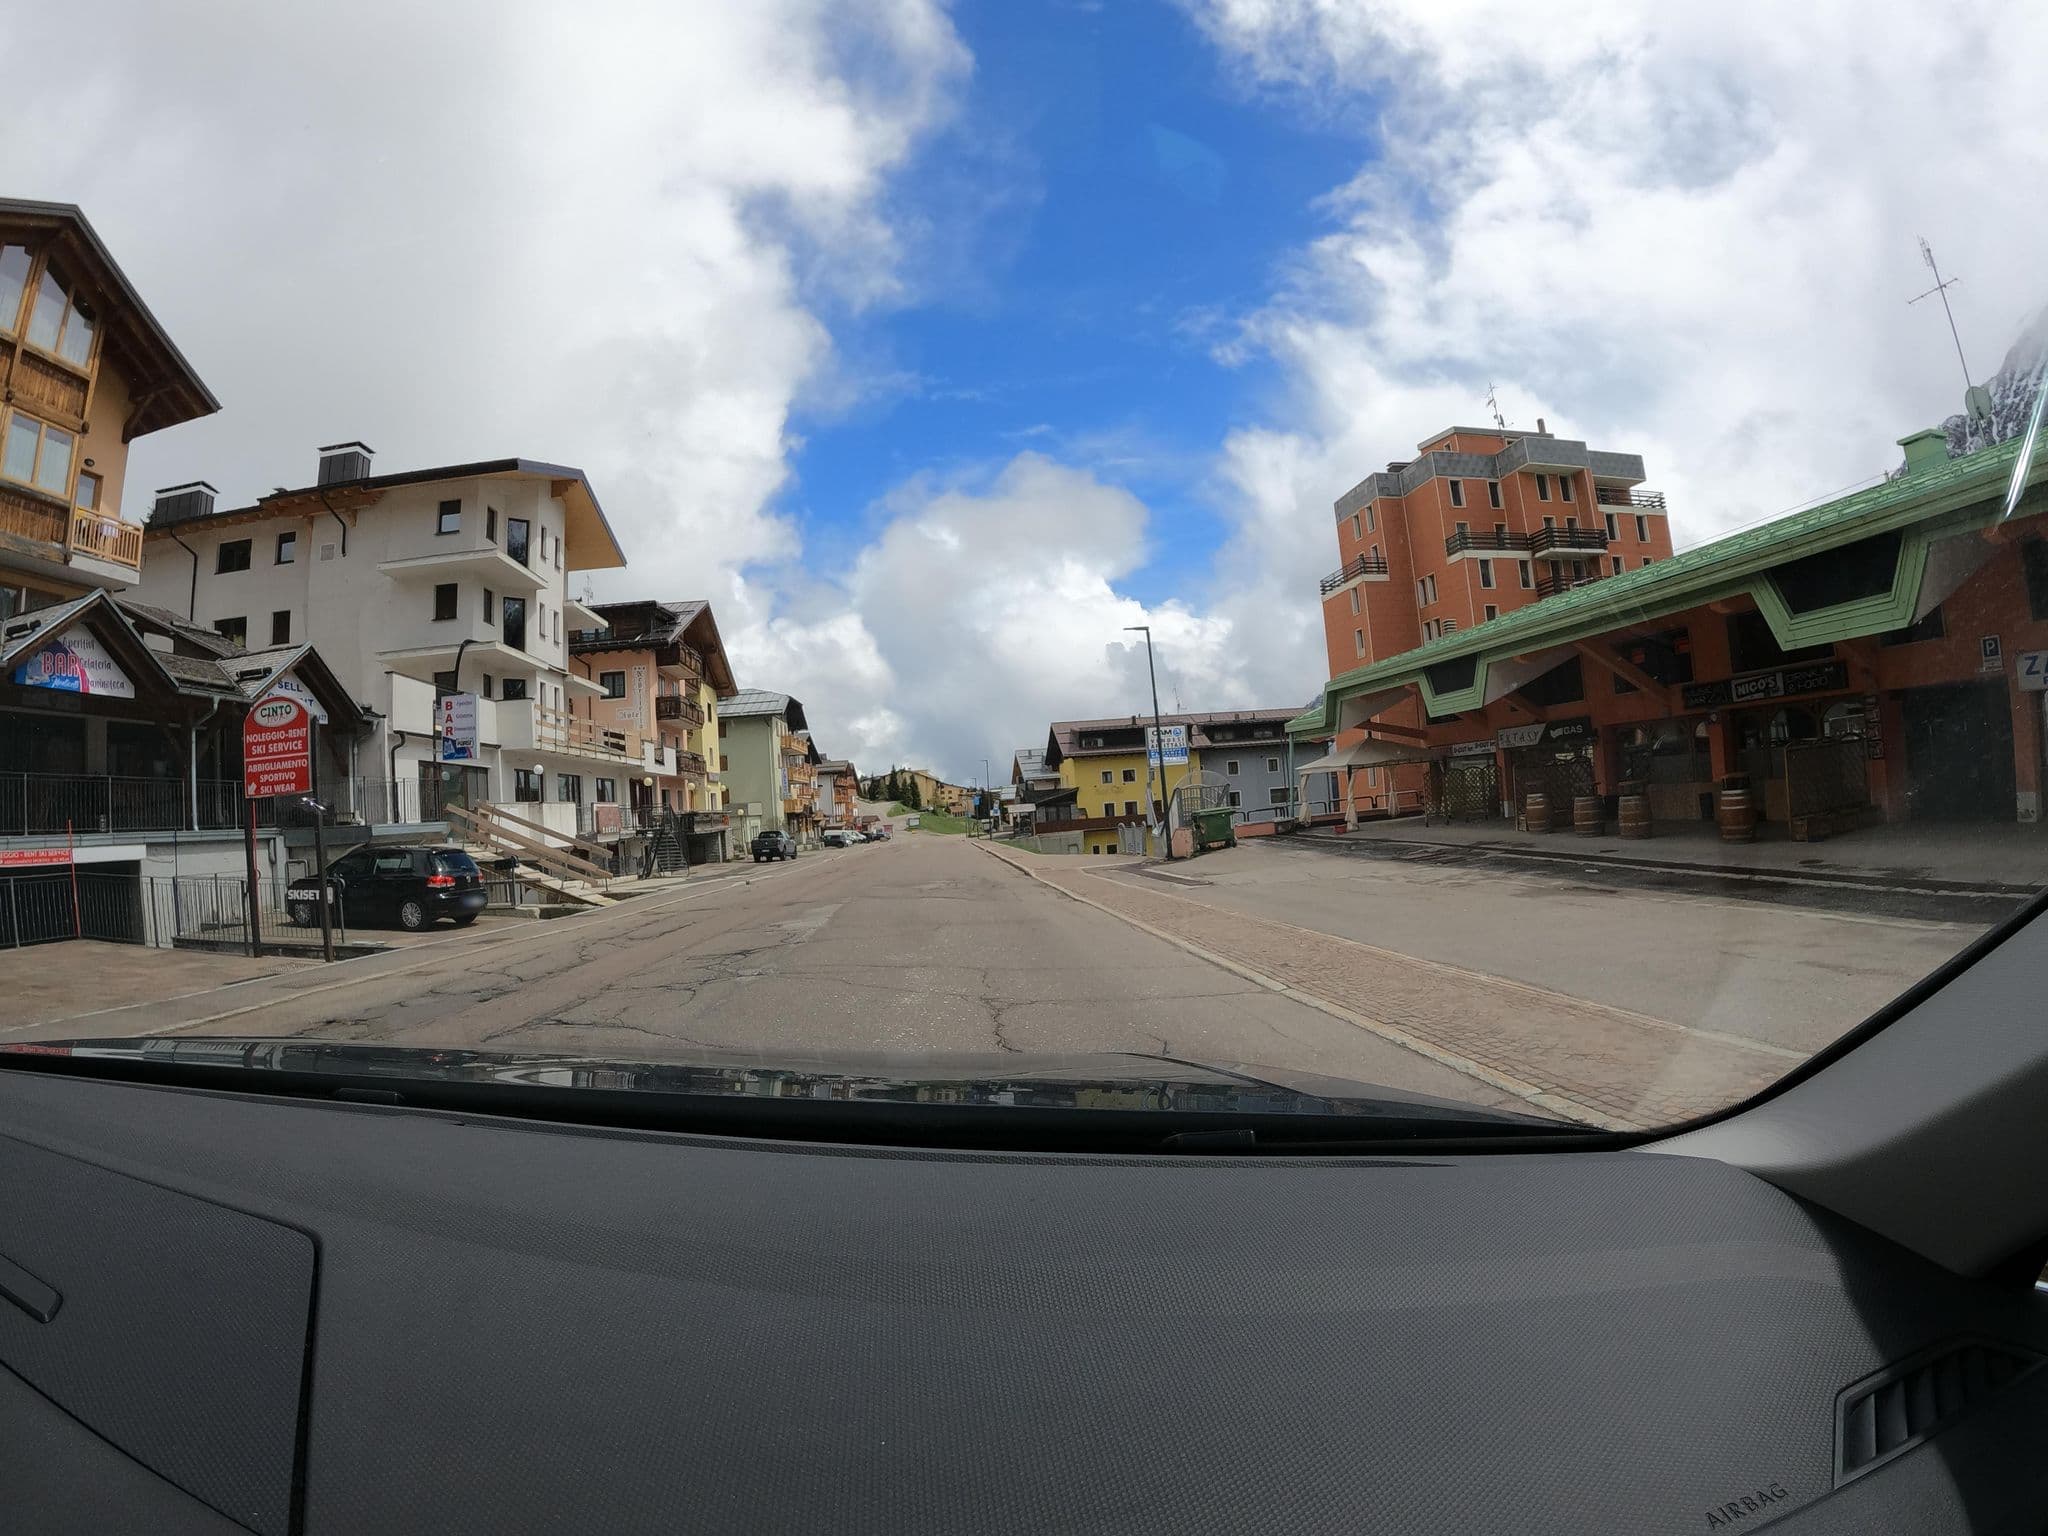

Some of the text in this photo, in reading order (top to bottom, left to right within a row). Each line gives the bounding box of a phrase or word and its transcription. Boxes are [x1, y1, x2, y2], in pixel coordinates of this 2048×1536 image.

[1985, 640, 1995, 656] P
[42, 651, 80, 677] BAR
[2024, 655, 2048, 676] Z
[277, 681, 303, 693] SELL
[1736, 675, 1776, 695] NICO'S
[260, 704, 292, 718] CINTO
[445, 701, 453, 736] BAR
[246, 728, 307, 743] NOLEGGIO-RENT
[1563, 725, 1583, 735] GAS
[252, 740, 303, 755] SKI SERVICE
[247, 758, 308, 773] ABBIGLIAMENTO
[259, 771, 296, 783] SPORTIVO
[260, 783, 296, 794] SKI WEAR
[287, 889, 320, 900] SKISET
[1705, 1483, 1788, 1530] AIRBAG
